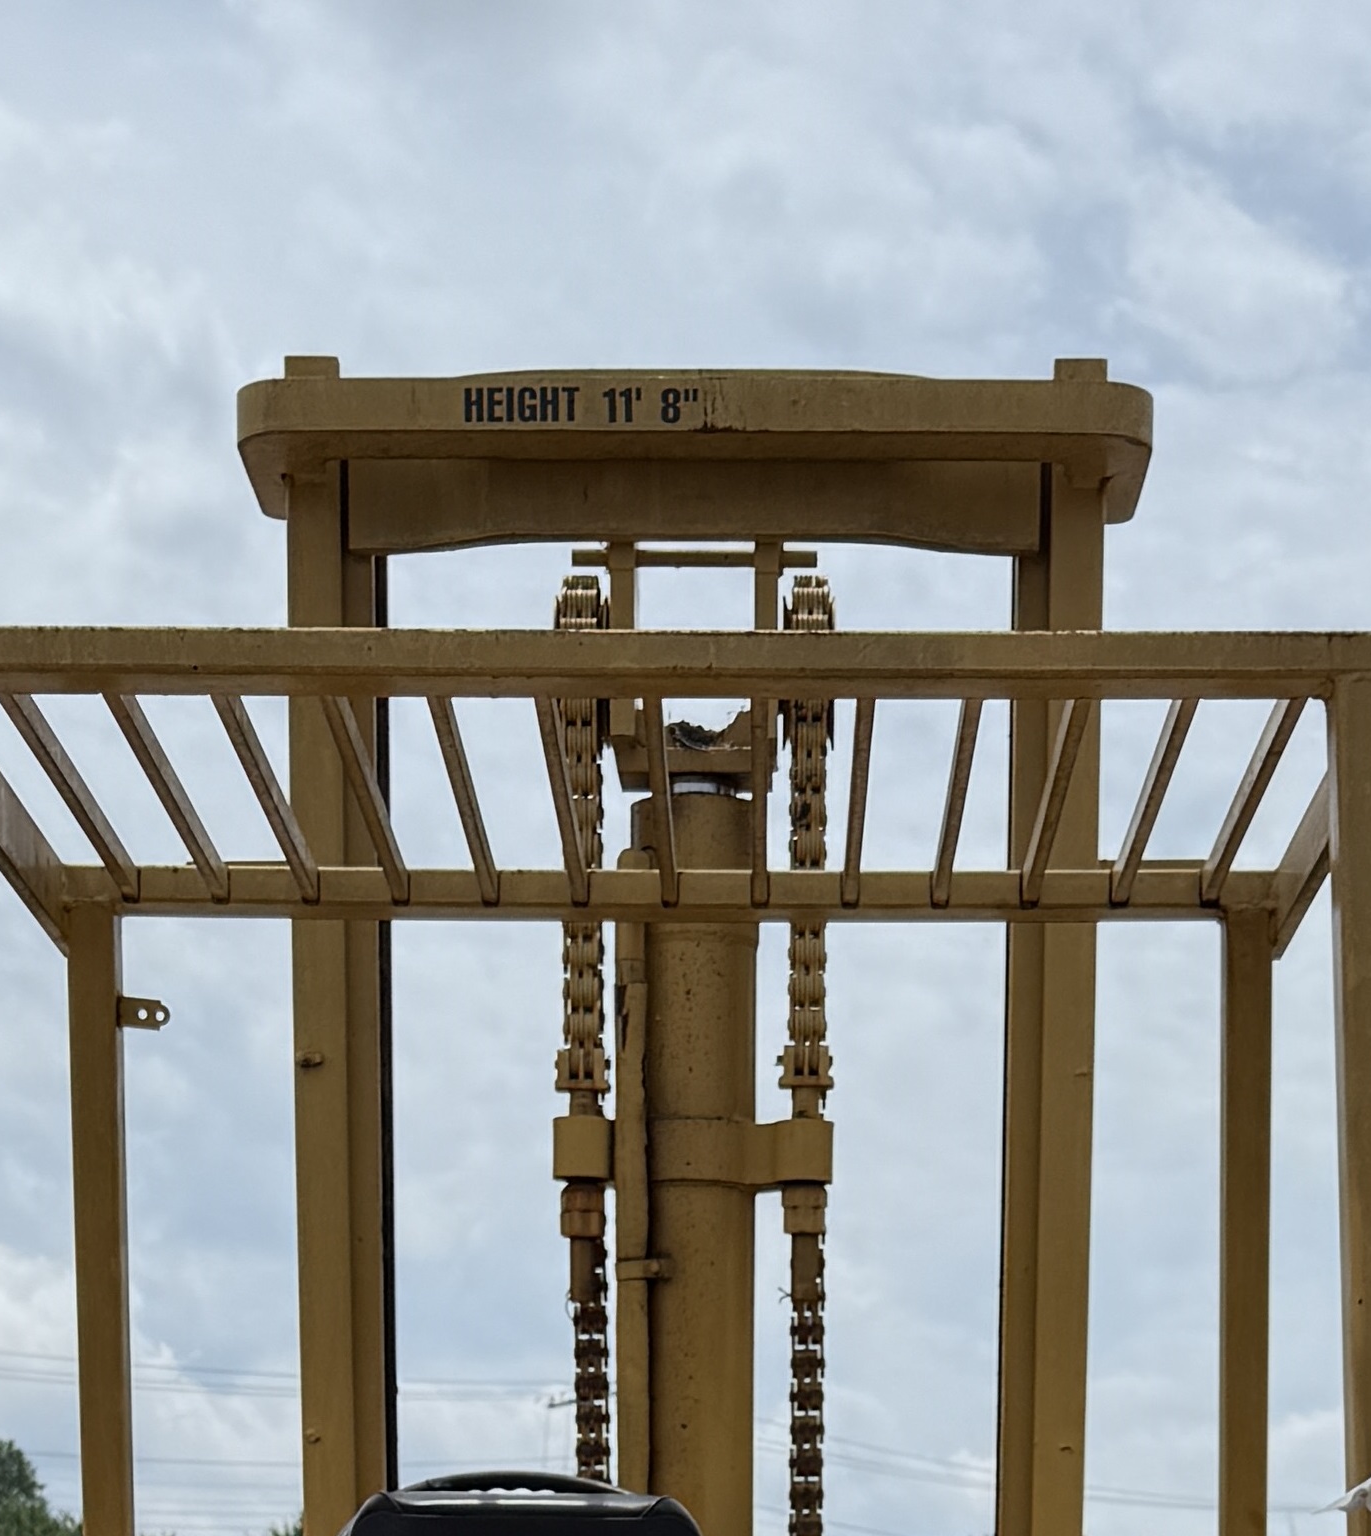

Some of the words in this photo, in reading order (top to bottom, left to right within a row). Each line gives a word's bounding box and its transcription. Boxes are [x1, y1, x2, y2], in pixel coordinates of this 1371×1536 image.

[463, 386, 580, 423] HEIGHT
[602, 387, 642, 423] 11'
[660, 387, 699, 424] 8"
